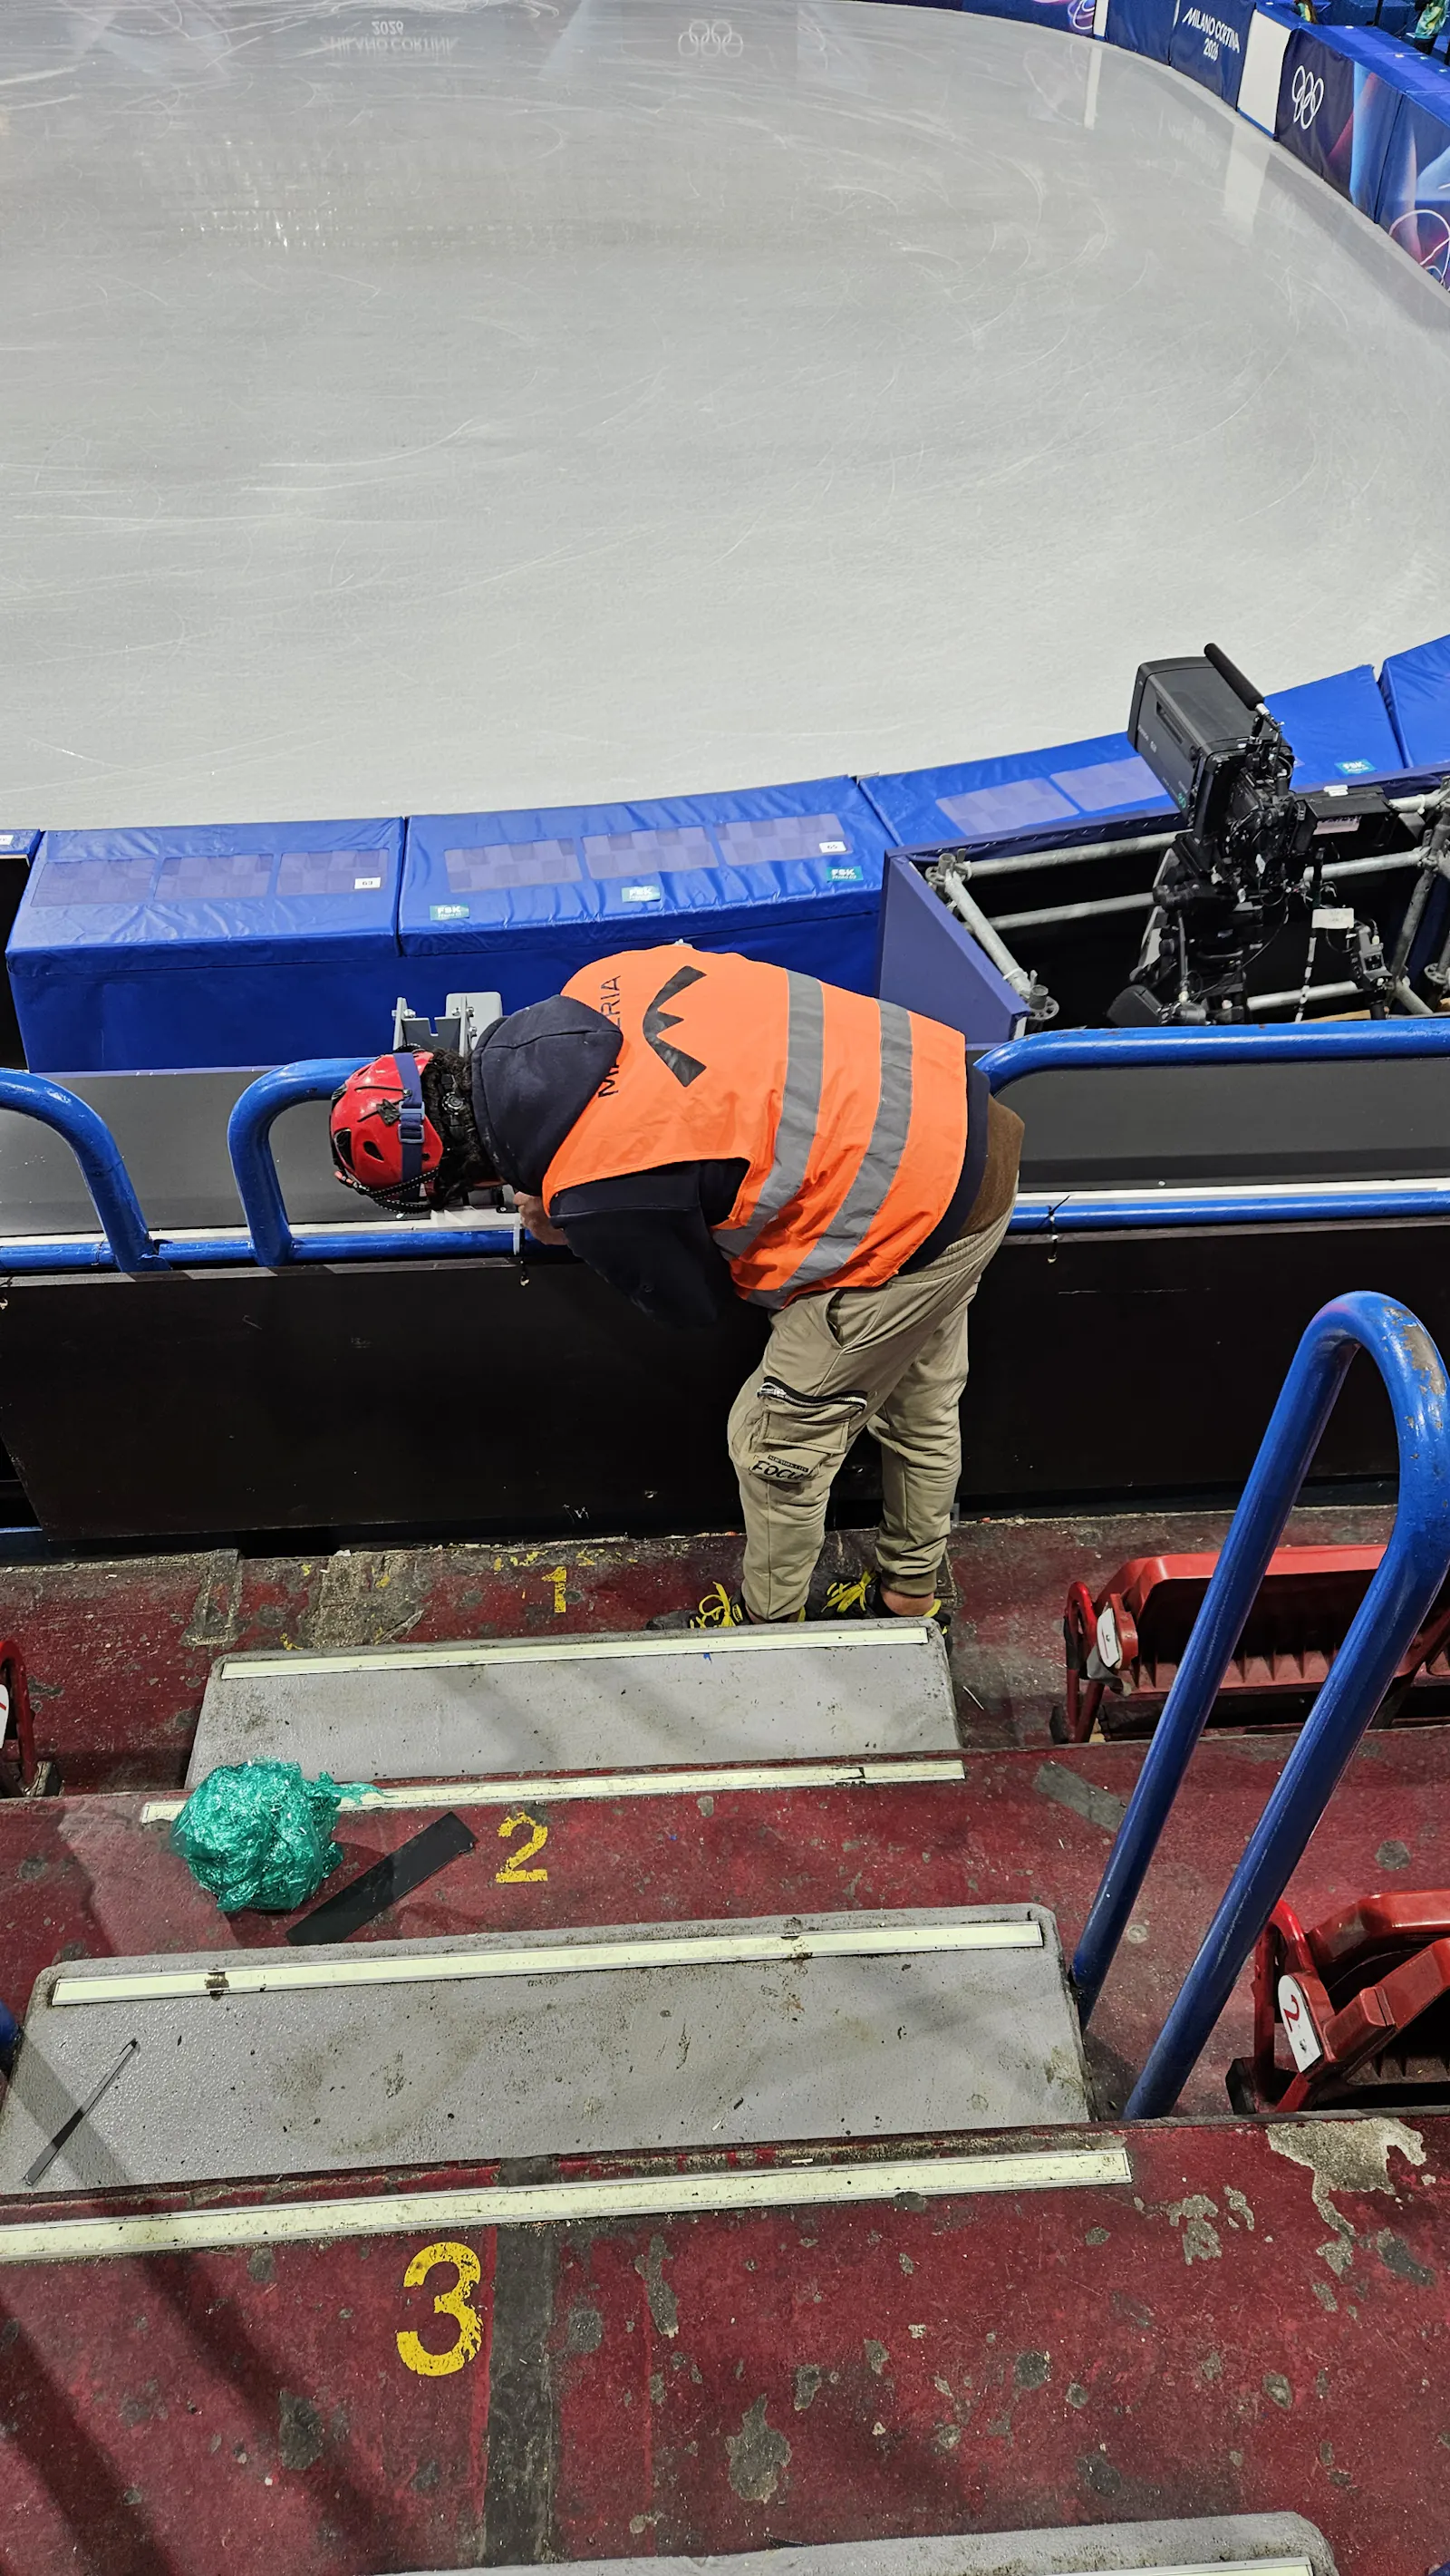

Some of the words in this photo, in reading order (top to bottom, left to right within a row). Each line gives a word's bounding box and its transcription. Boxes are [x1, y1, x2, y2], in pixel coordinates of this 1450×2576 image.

[1182, 7, 1215, 36] MILANO
[1215, 20, 1240, 53] CORTINA
[1203, 37, 1220, 62] 2026
[437, 905, 461, 914] FSK
[541, 1566, 566, 1612] 1
[495, 1812, 548, 1883] 2
[1283, 1994, 1300, 2032] 2
[397, 2242, 483, 2377] 3
